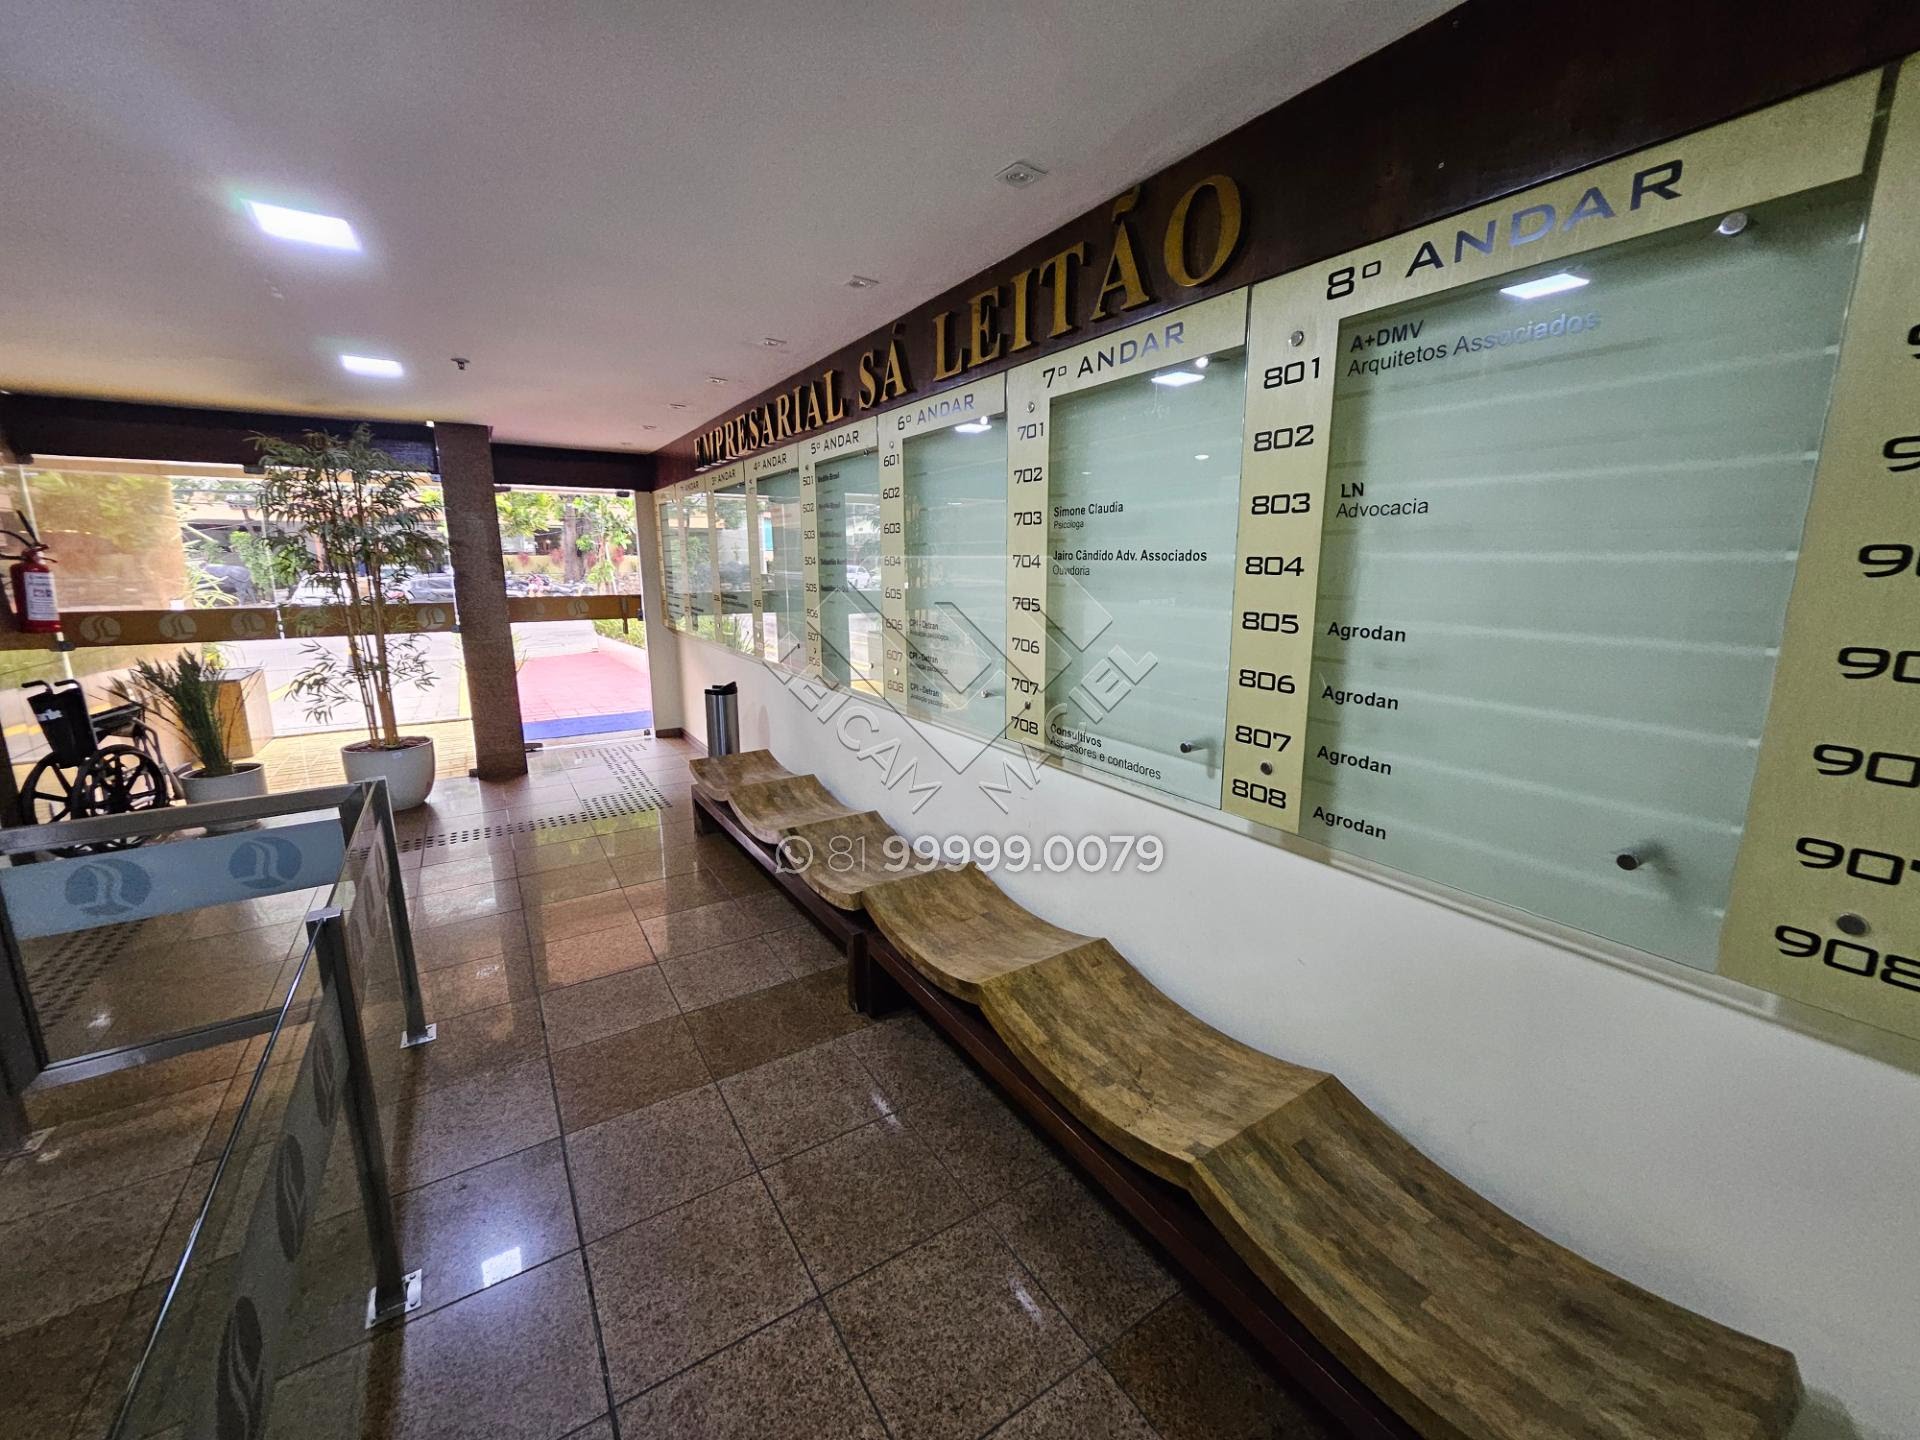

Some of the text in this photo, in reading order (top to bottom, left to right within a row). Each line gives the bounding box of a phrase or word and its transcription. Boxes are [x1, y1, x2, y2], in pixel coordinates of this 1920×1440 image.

[1405, 159, 1683, 277] ANDAR
[693, 173, 1243, 470] EMPRESARIAL SÁ LEITÃO
[1347, 312, 1599, 377] Arquitetos Associados
[1349, 320, 1424, 353] A+DMV
[1077, 321, 1185, 379] ANDAR
[1263, 357, 1320, 389] 801
[917, 393, 974, 425] ANDAR
[824, 430, 859, 452] ANDAR
[1017, 422, 1045, 441] 701
[1253, 425, 1314, 452] 802
[762, 453, 787, 469] ANDAR
[883, 453, 900, 467] 601
[1013, 467, 1043, 484] 702
[882, 486, 900, 500] 602
[1340, 482, 1365, 498] LN
[1053, 501, 1124, 518] Simone Claudia
[1251, 493, 1310, 515] 803
[1336, 499, 1429, 519] Advocacia
[883, 522, 901, 535] 603
[1013, 511, 1042, 526] 703
[884, 555, 901, 567] 604
[1012, 554, 1042, 568] 704
[1052, 549, 1207, 562] Jairo Cândido Adv. Associados
[1245, 556, 1304, 577] 804
[884, 588, 902, 600] 605
[1012, 597, 1041, 613] 705
[1242, 612, 1299, 634] 805
[1327, 622, 1407, 642] Agrodan
[886, 649, 903, 662] 607
[1012, 637, 1040, 654] 706
[1011, 677, 1040, 696] 707
[1239, 669, 1295, 694] 806
[1321, 685, 1399, 711] Agrodan
[1010, 716, 1039, 736] 708
[1050, 723, 1103, 748] Consultivos
[1235, 725, 1292, 752] 807
[1108, 756, 1161, 781] contadores
[1316, 746, 1392, 775] Agrodan
[1232, 779, 1287, 809] 808
[1312, 806, 1387, 840] Agrodan
